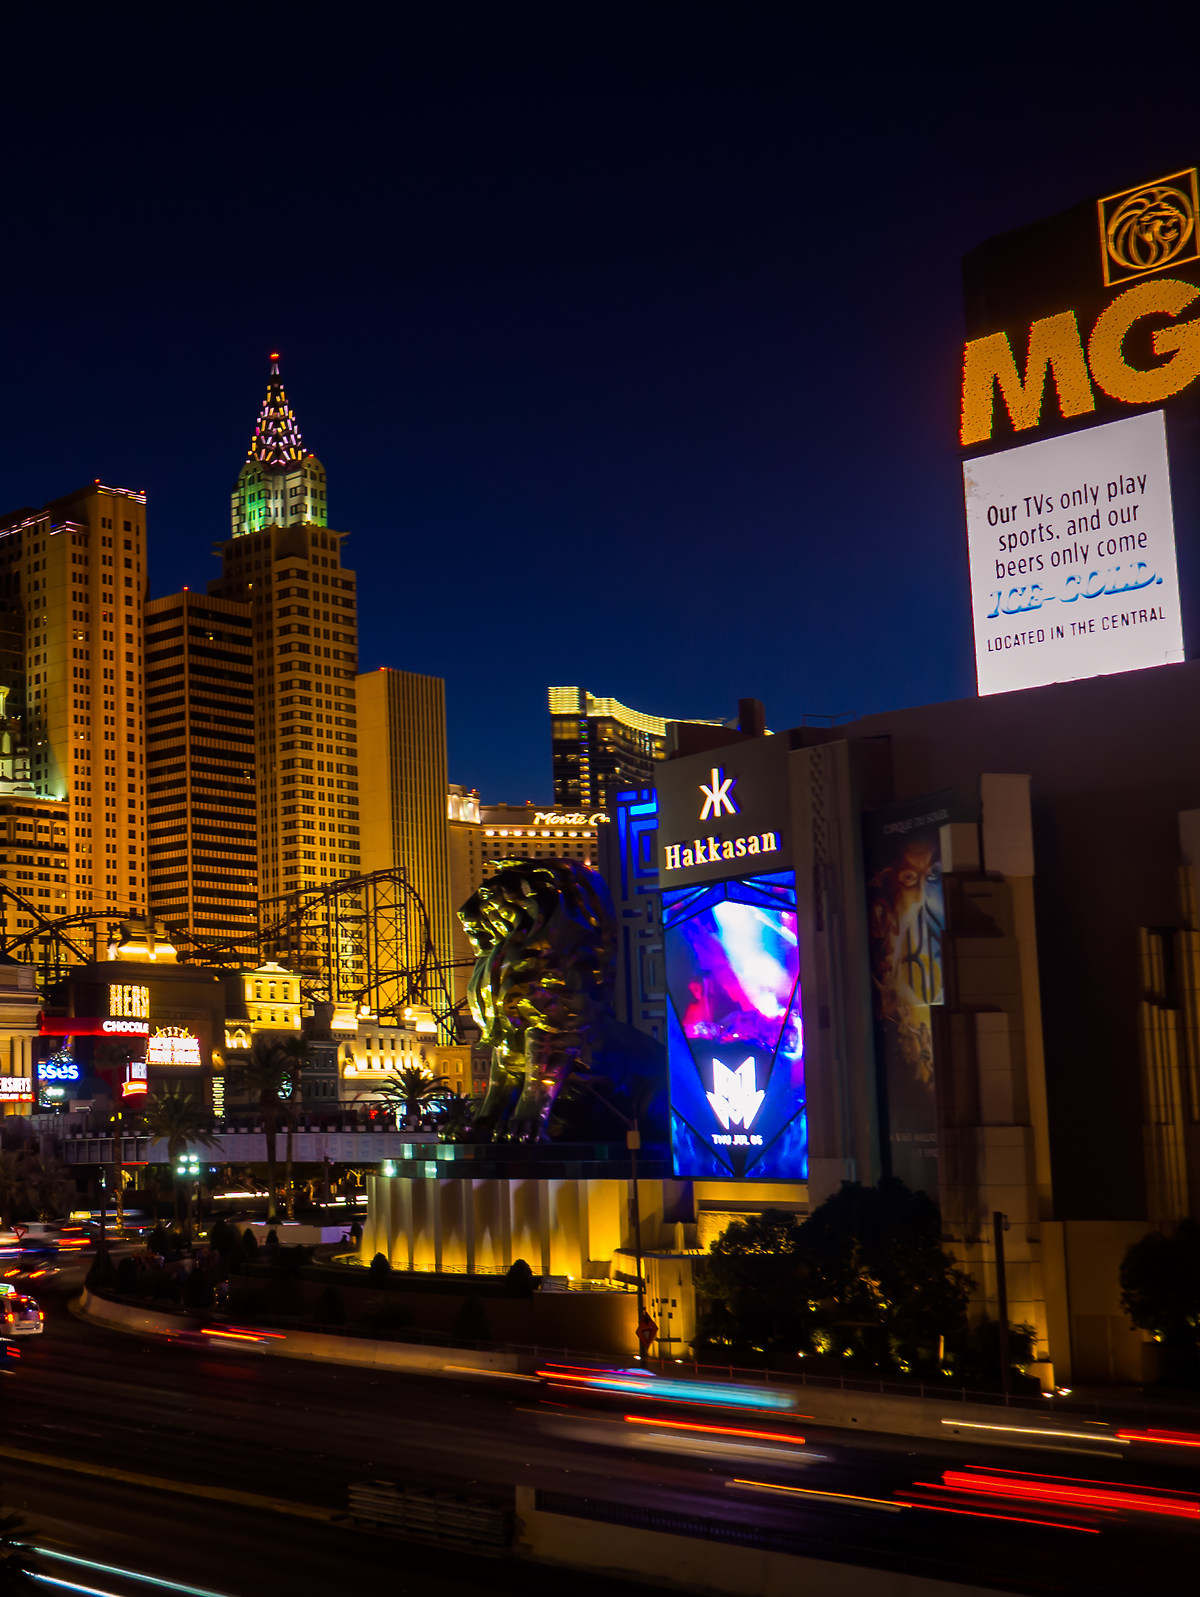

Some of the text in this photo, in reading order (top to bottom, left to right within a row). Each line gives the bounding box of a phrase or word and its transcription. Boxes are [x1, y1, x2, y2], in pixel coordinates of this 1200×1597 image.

[987, 474, 1147, 526] Our TVs only play
[1067, 509, 1101, 536] and
[1108, 505, 1139, 526] our
[996, 532, 1148, 579] beers only come
[987, 606, 1166, 652] LOCATED IN THE CENTRAL
[533, 812, 588, 825] Monte
[663, 832, 779, 870] Hakkasan
